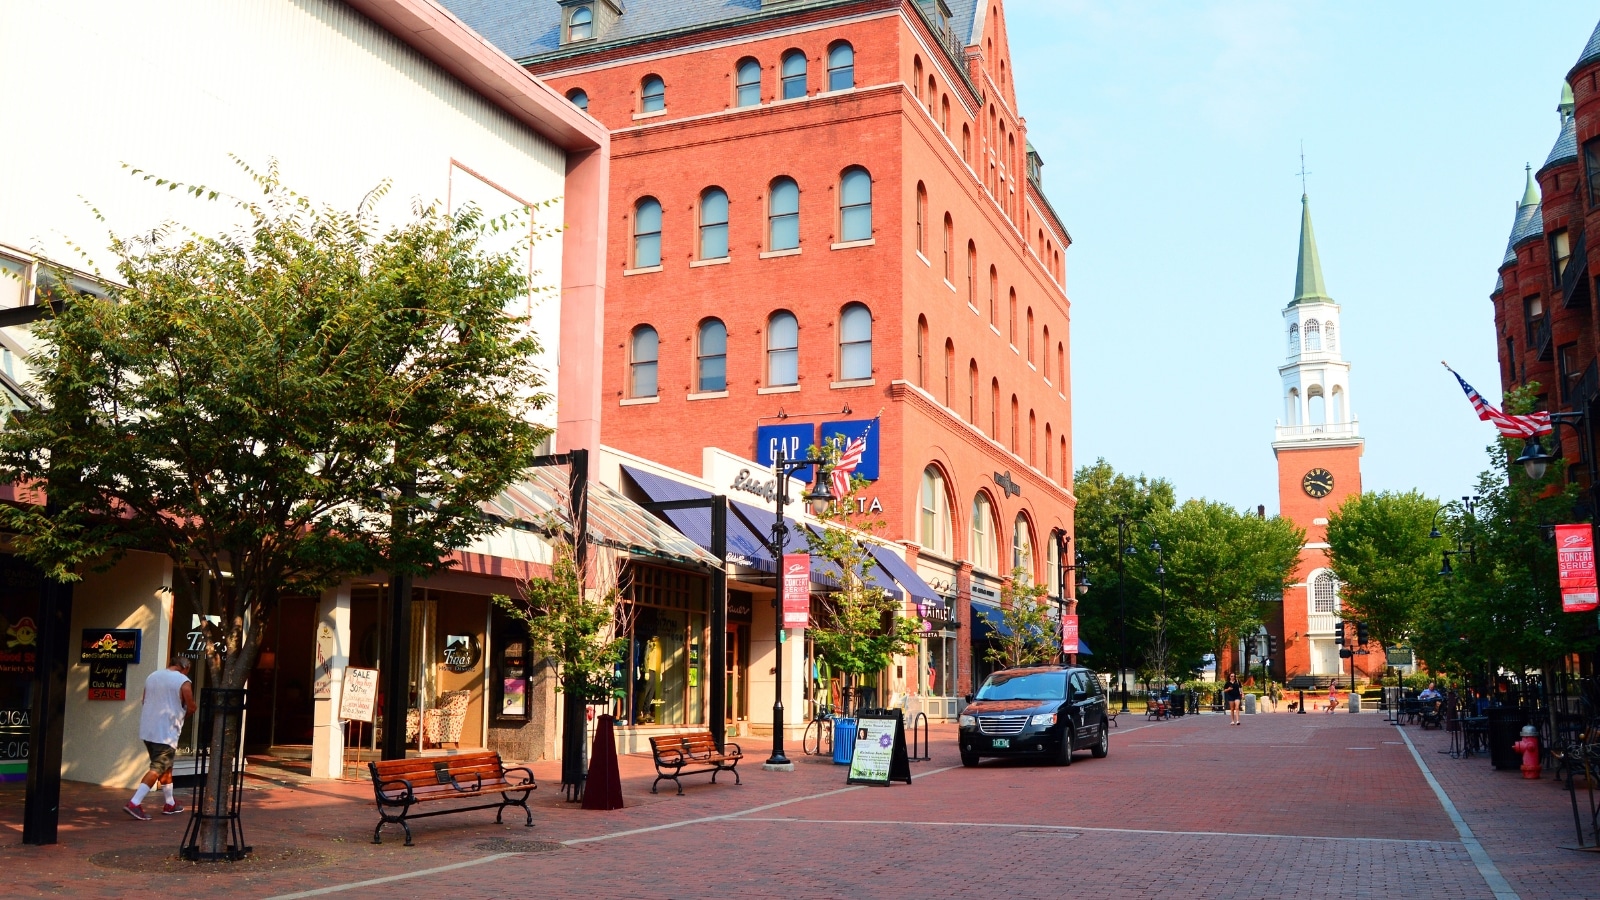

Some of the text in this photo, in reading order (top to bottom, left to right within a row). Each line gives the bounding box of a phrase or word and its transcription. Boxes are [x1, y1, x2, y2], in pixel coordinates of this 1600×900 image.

[770, 436, 800, 462] GAP
[1559, 552, 1592, 562] CONCERT
[1560, 561, 1593, 570] SERIES
[785, 578, 808, 587] CONCERT
[926, 606, 955, 622] ATHLETA
[352, 669, 371, 680] SALE
[93, 690, 121, 699] SALE
